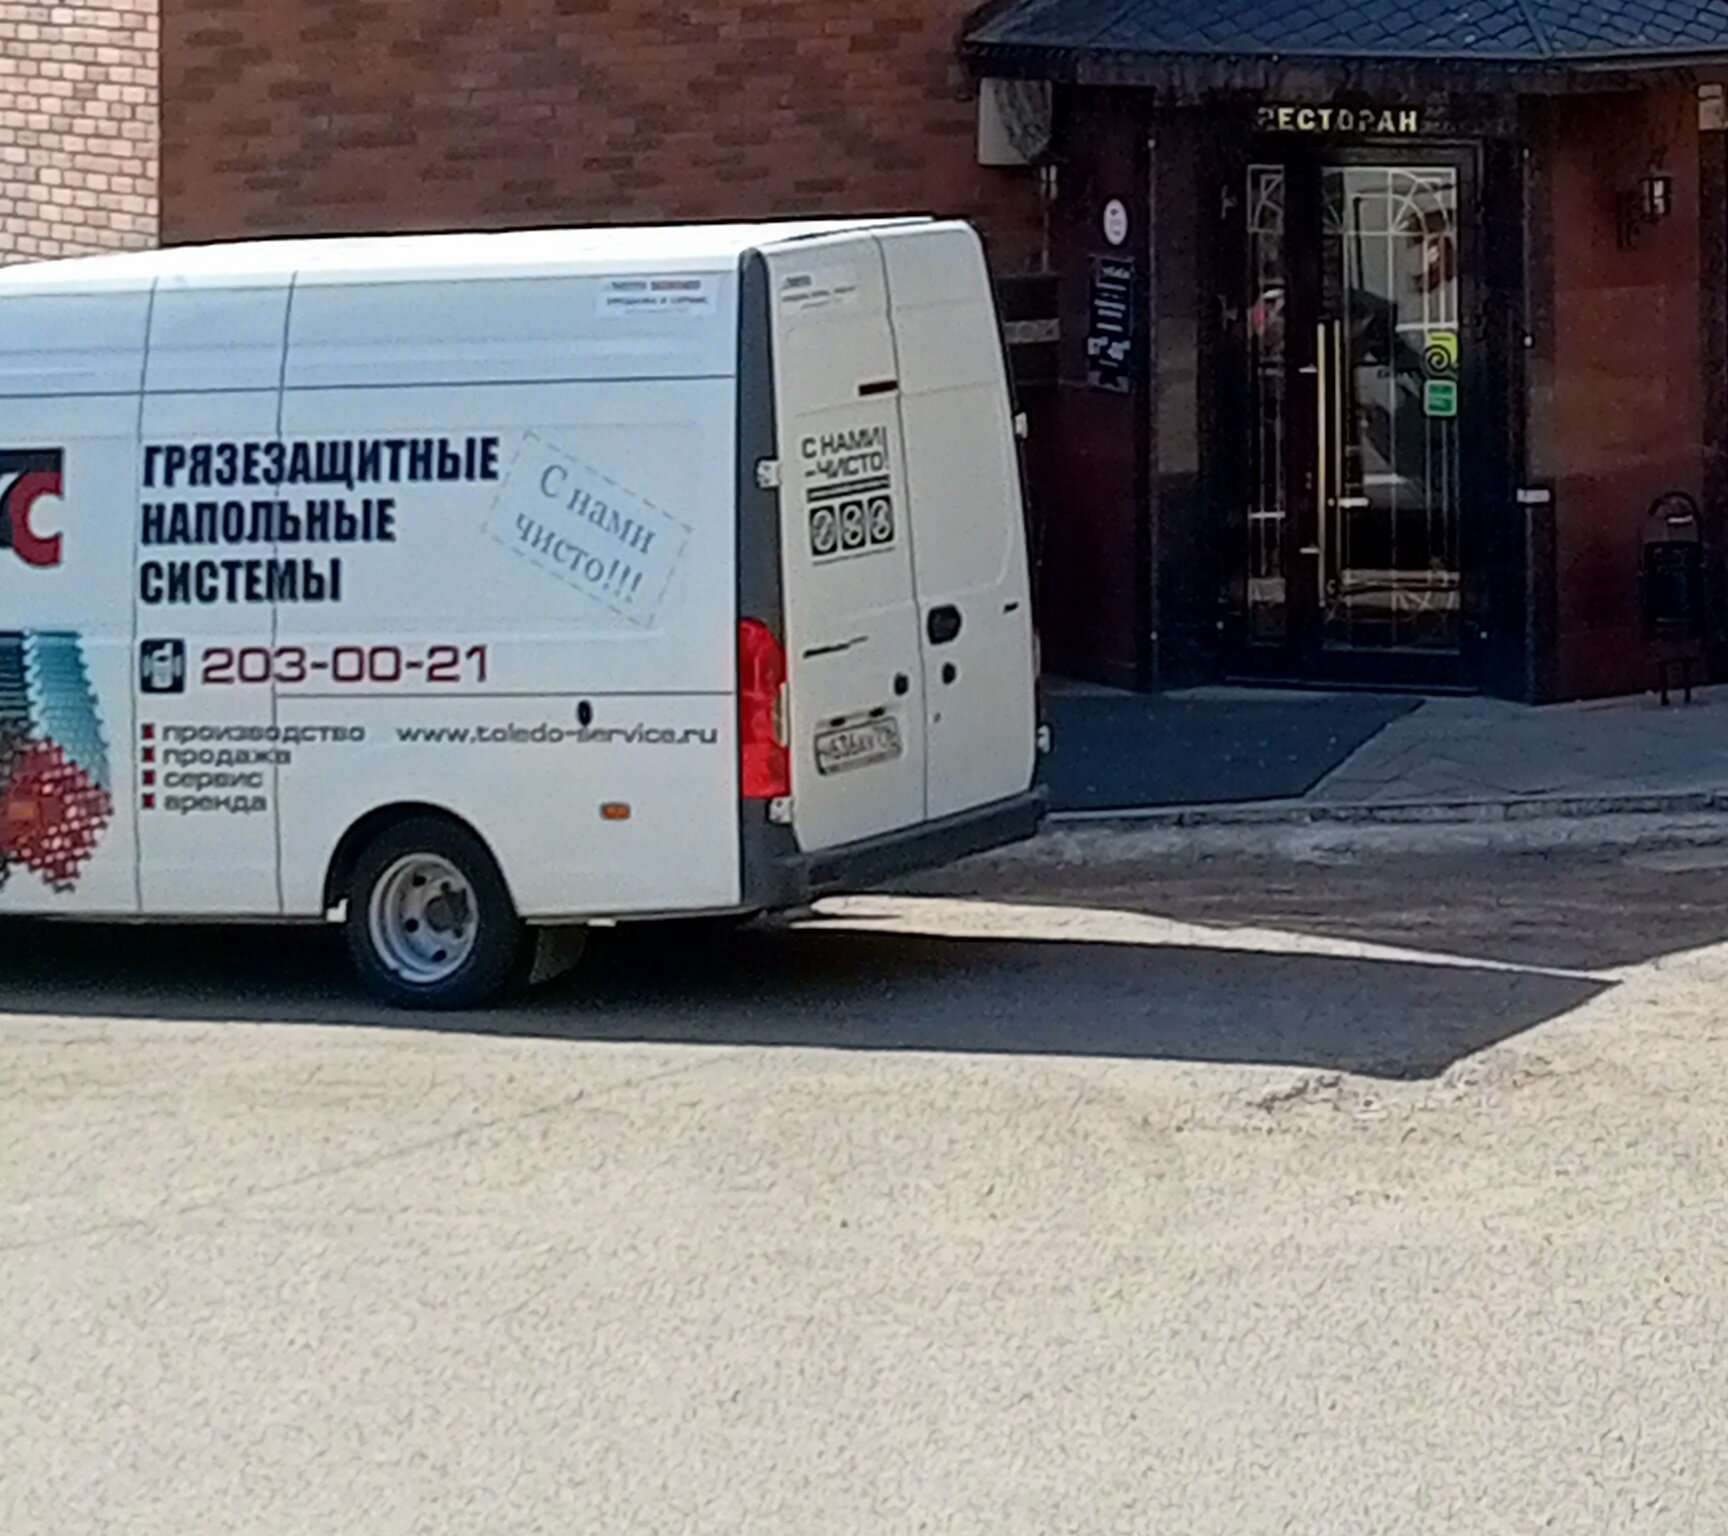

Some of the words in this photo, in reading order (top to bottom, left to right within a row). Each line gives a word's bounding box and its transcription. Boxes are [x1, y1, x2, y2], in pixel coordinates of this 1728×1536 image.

[1257, 106, 1418, 133] РЕСТОРАН
[143, 437, 499, 491] ГРЯЗЕЗАЩИТНЫЕ
[140, 497, 397, 546] НАПОЛЬНЫЕ
[540, 463, 568, 499] С
[566, 488, 657, 555] нами
[515, 512, 644, 605] чисто!!!
[139, 557, 342, 605] СИСТЕМЫ
[202, 644, 488, 685] 203-00-21
[162, 725, 366, 746] производство
[162, 746, 292, 768] продажа
[162, 770, 264, 792] сервис
[162, 793, 268, 816] аренда
